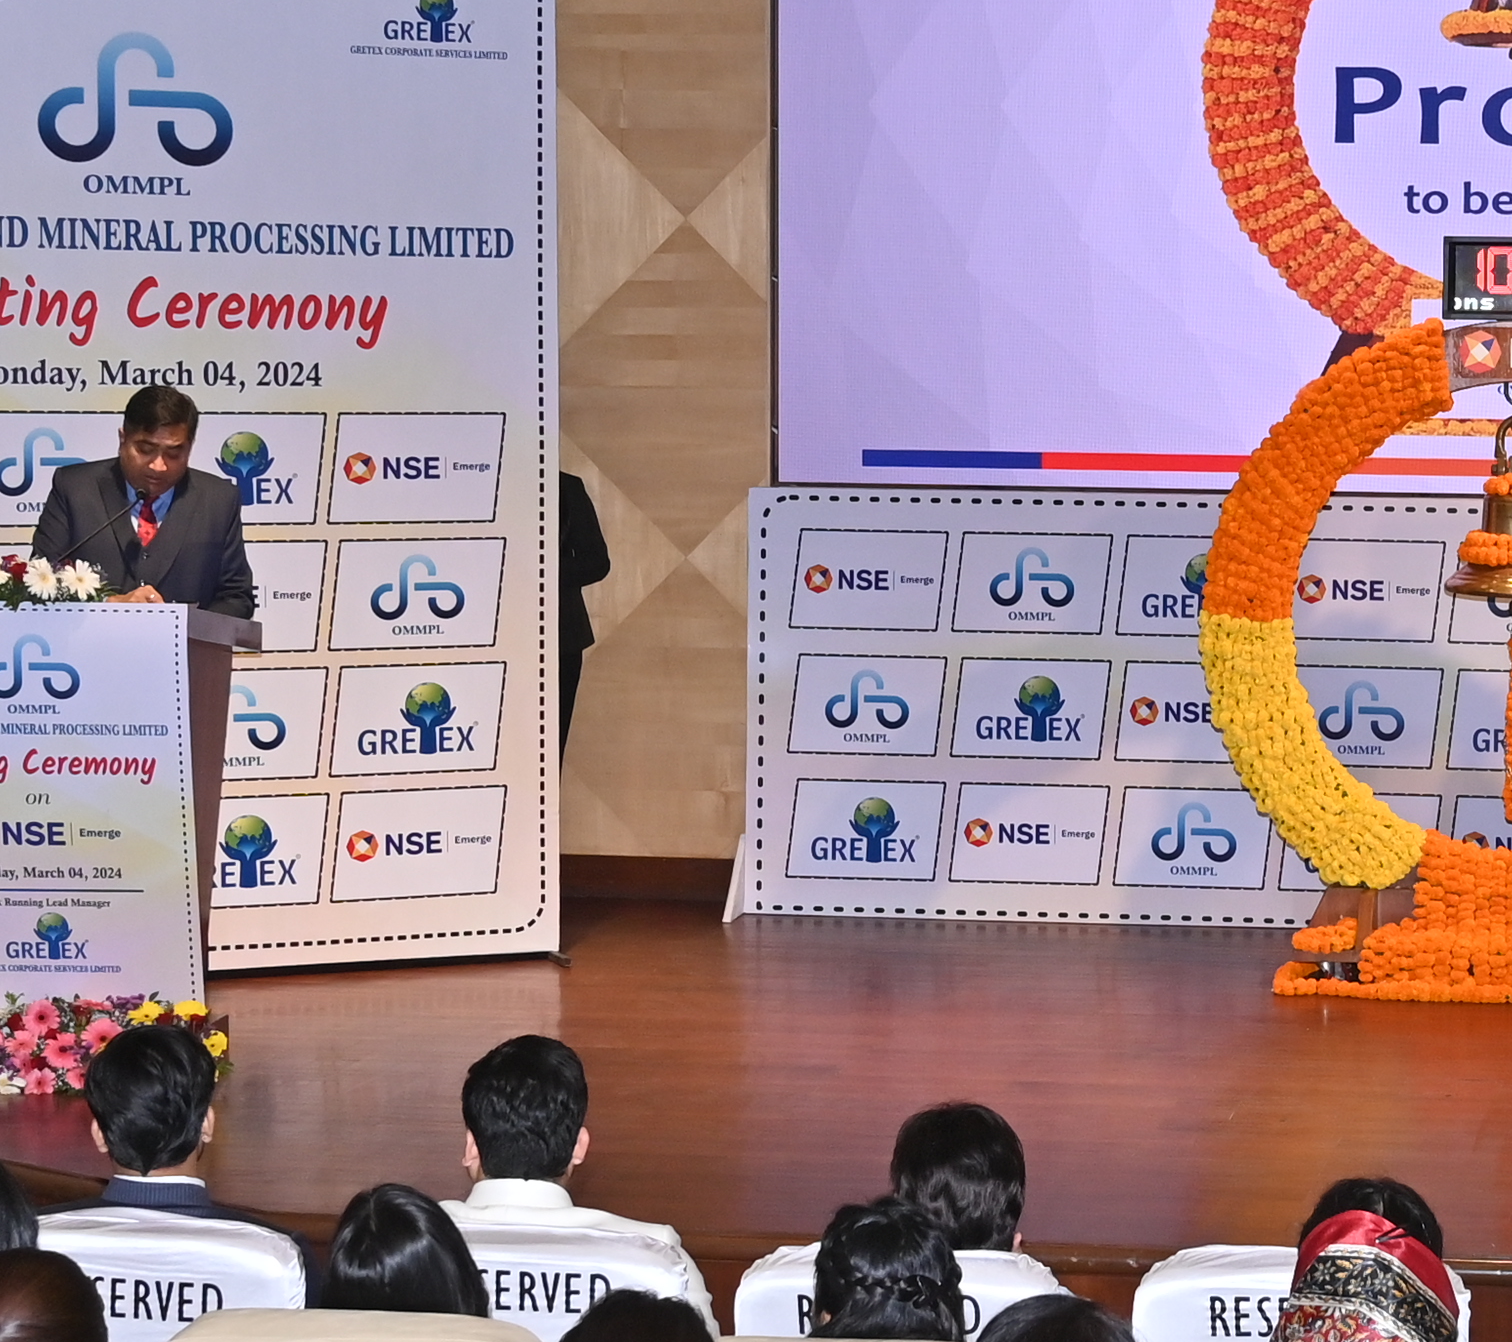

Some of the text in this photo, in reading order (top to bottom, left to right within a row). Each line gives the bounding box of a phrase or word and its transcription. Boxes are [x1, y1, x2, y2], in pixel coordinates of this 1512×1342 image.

[350, 45, 508, 60] GRETEX CORPORATE SERVICES LIMITED
[82, 173, 191, 197] OMMPL
[1405, 186, 1449, 215] to
[37, 215, 182, 252] MINERAL
[189, 220, 381, 256] PROCESSING
[389, 226, 514, 258] LIMITED
[127, 275, 388, 349] Ceremony
[98, 358, 194, 386] March
[203, 360, 246, 393] 04,
[257, 361, 323, 387] 2024
[381, 456, 440, 480] NSE
[838, 569, 890, 591] NSE
[1332, 579, 1384, 601] NSE
[1008, 610, 1056, 622] OMMPL
[392, 624, 445, 636] OMMPL
[7, 704, 60, 714] OMMPL
[1164, 701, 1211, 723] NSE
[1, 724, 50, 736] MINERAL
[52, 724, 120, 736] PROCESSING
[122, 725, 168, 736] LIMITED
[23, 749, 156, 785] Ceremony
[25, 793, 51, 805] on
[2, 822, 121, 846] NSE Emerge
[384, 830, 443, 855] NSE
[998, 822, 1050, 845] NSE
[23, 867, 64, 879] March
[69, 867, 88, 882] 04,
[92, 867, 122, 879] 2024
[5, 898, 43, 908] Running
[46, 899, 68, 907] Lead
[71, 899, 111, 908] Manager
[93, 1277, 225, 1323] SERVED
